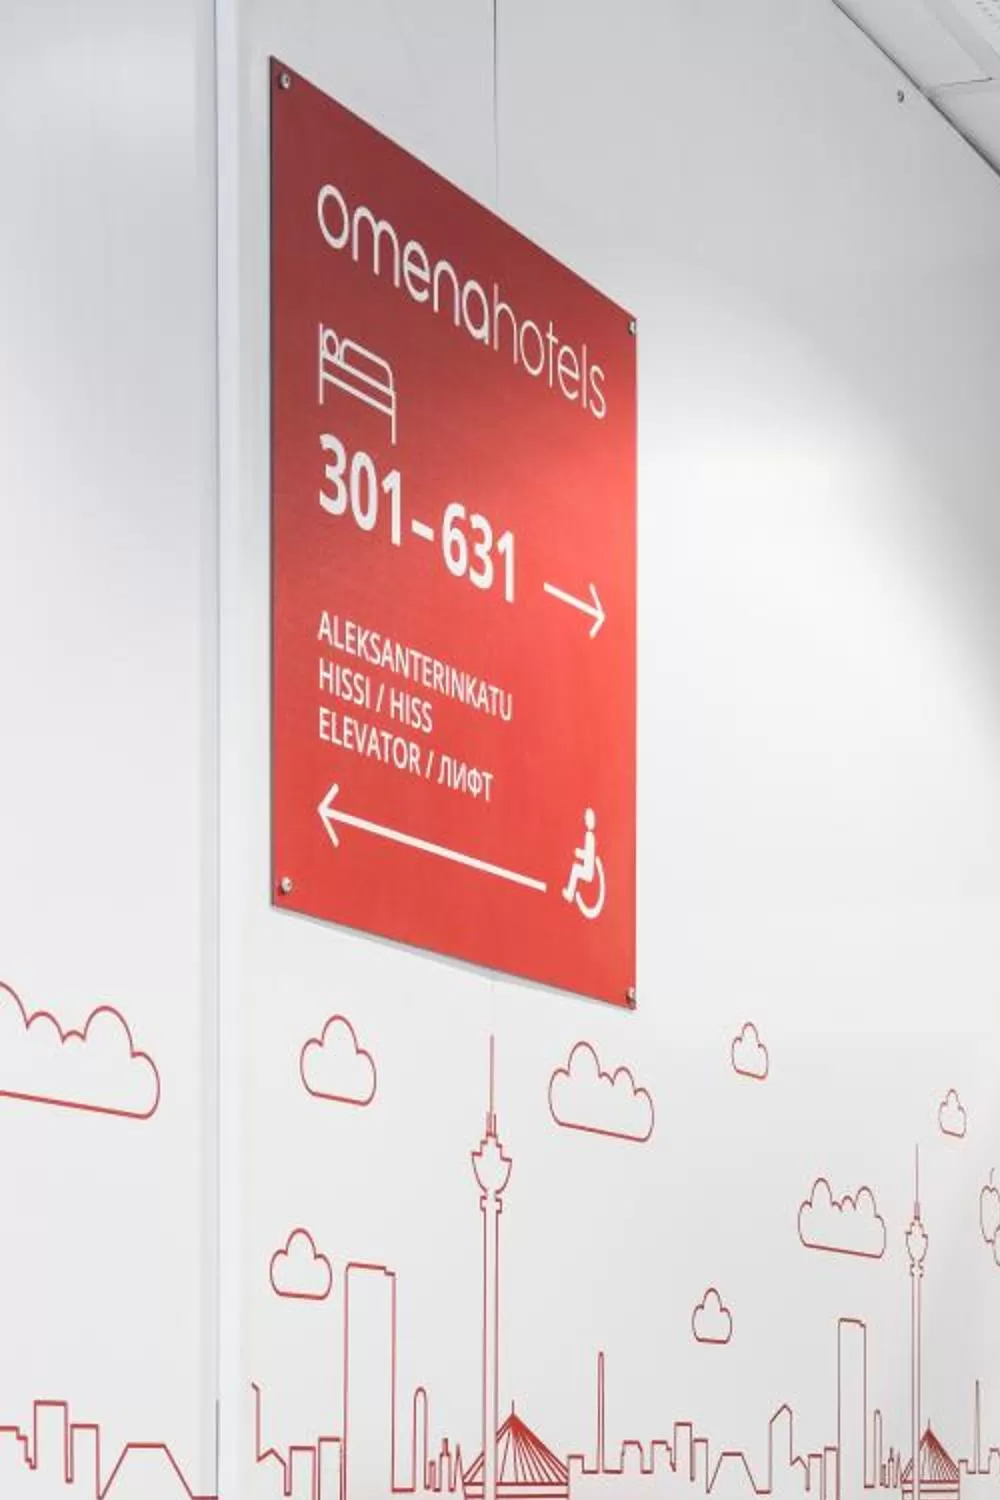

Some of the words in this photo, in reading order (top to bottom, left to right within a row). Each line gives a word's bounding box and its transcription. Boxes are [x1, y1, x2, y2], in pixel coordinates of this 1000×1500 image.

[317, 184, 606, 419] omenahotels
[317, 611, 513, 722] ALEKSANTERINKATU
[318, 656, 371, 708] HISSI
[390, 685, 433, 735] HISS
[319, 707, 422, 777] ELEVATOR
[438, 752, 494, 802] ЛИФТ
